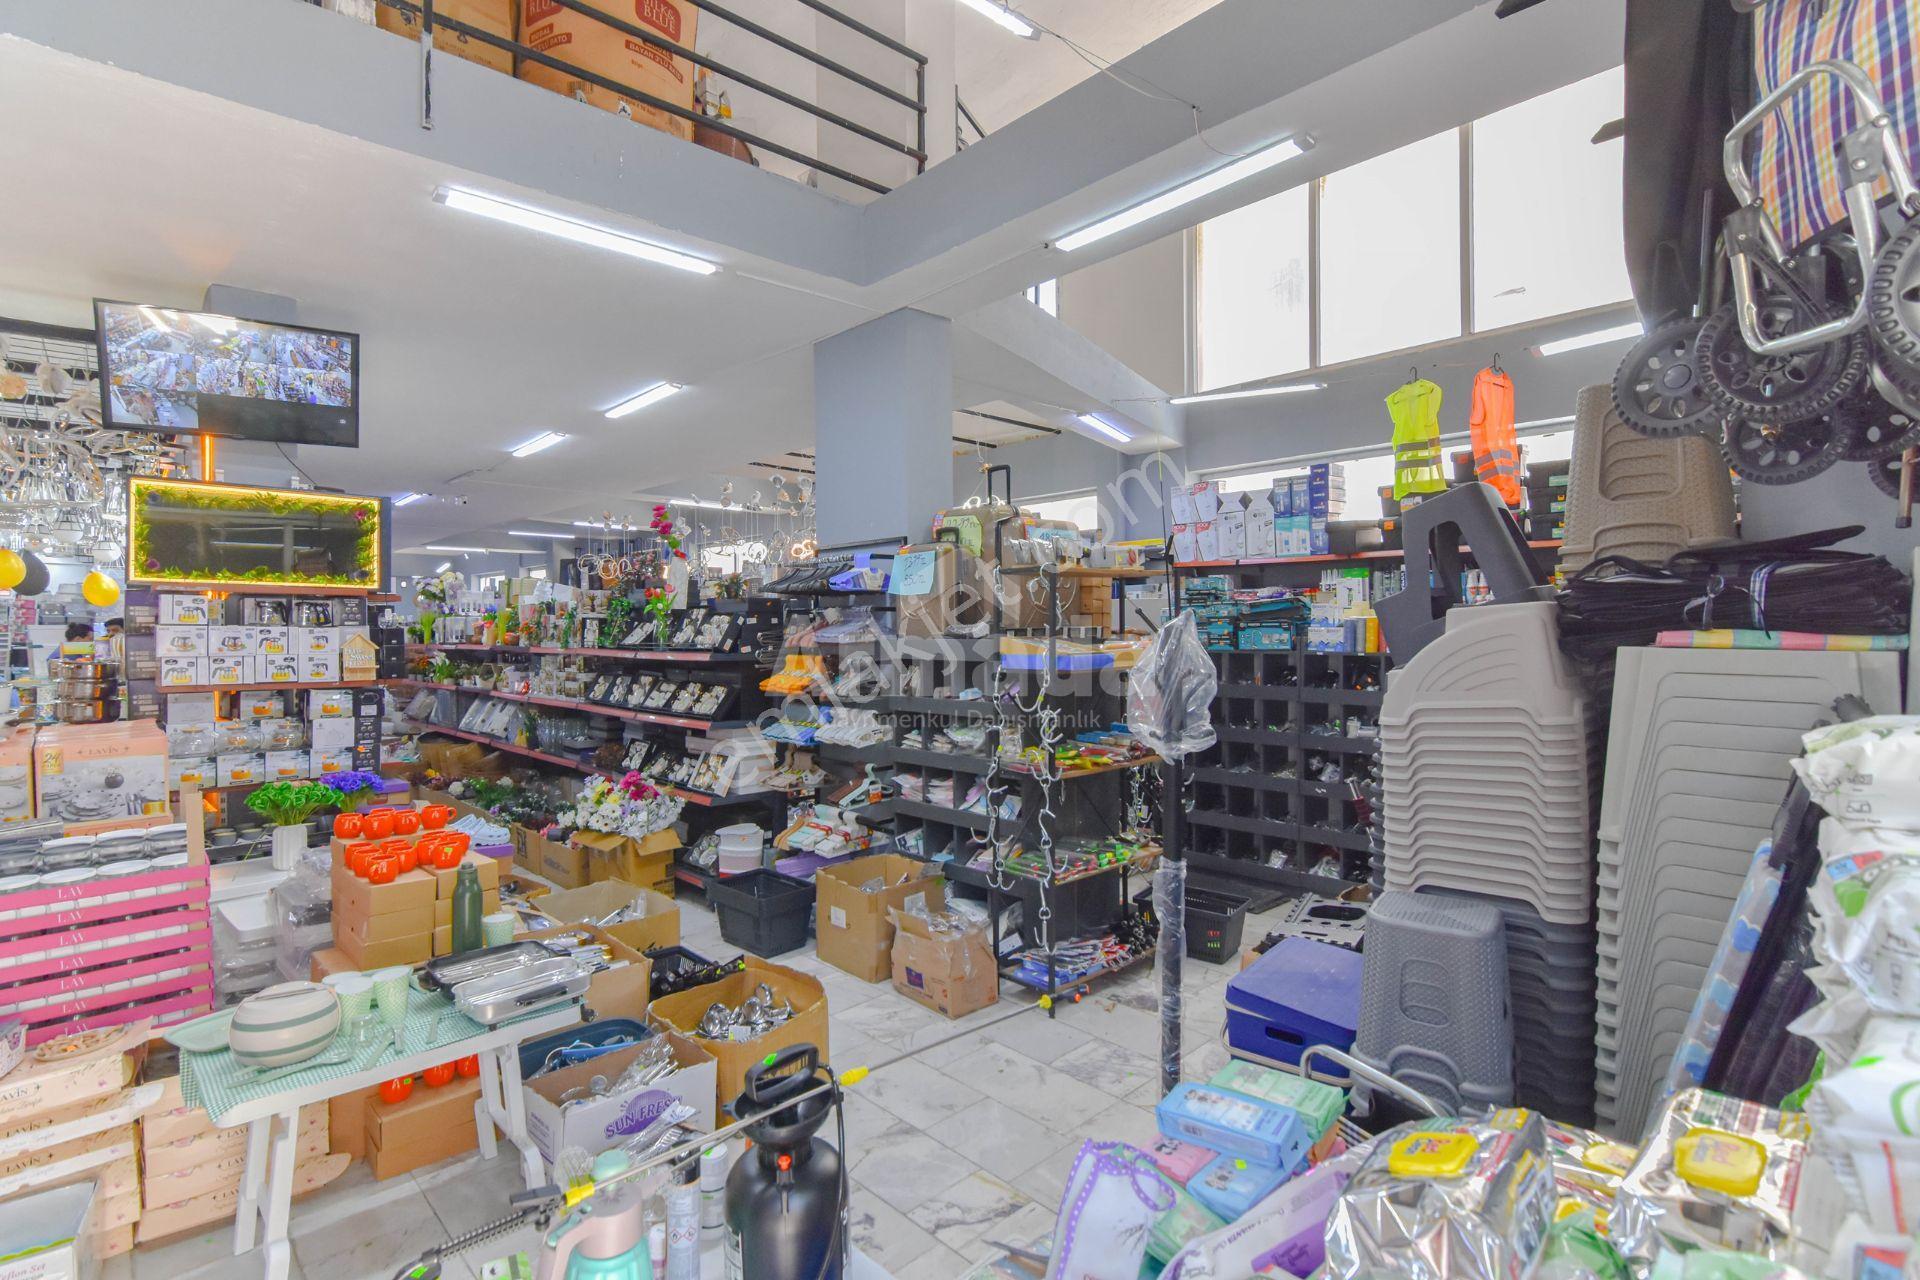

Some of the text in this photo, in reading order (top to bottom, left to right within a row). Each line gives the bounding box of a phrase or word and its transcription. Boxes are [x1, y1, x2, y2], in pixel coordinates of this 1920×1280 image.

[644, 5, 675, 33] BLUE
[57, 886, 84, 899] LAV
[57, 911, 83, 924] LAV
[59, 932, 84, 946] LAV
[59, 957, 86, 971] LAV
[60, 976, 86, 990] LAV
[62, 1000, 88, 1014] LAV
[64, 1023, 89, 1037] LAV
[604, 1112, 636, 1139] SUN
